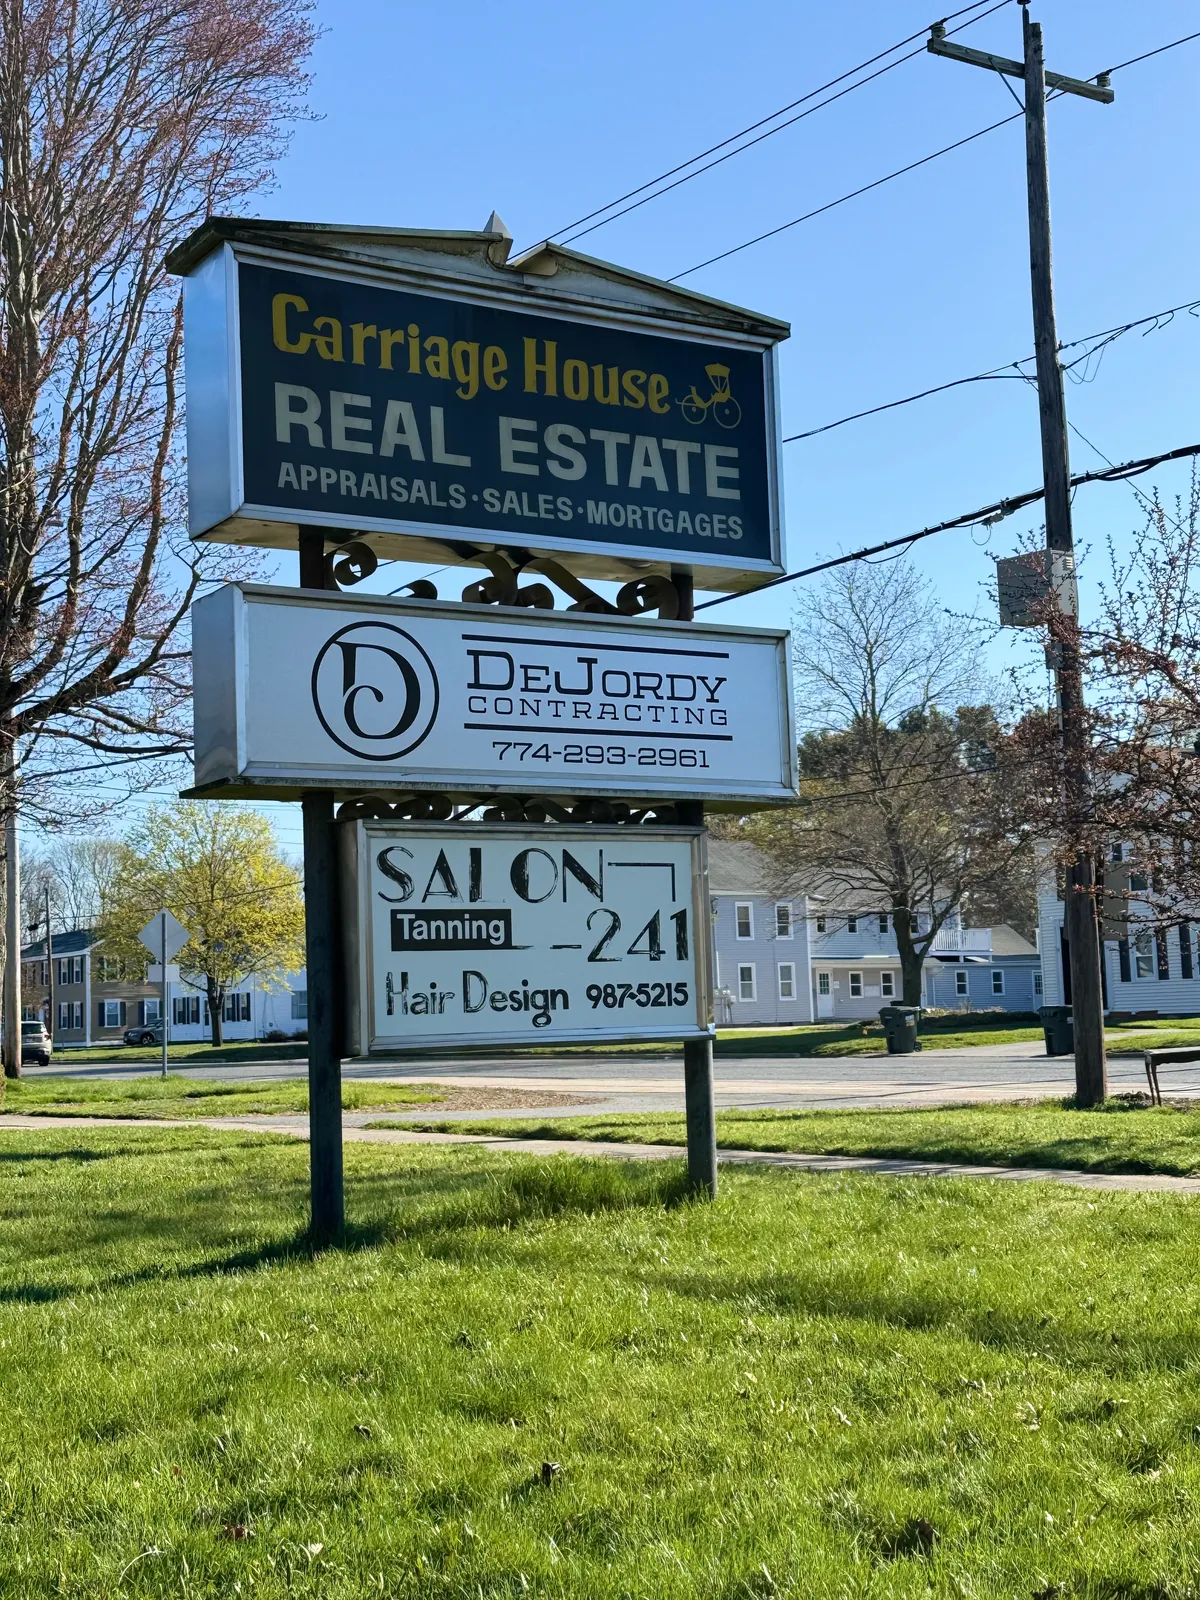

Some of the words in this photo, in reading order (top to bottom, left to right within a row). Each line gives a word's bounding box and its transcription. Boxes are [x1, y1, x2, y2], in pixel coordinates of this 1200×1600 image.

[272, 293, 508, 400] Carriage
[522, 337, 671, 414] House
[274, 382, 472, 468] REAL
[498, 416, 742, 500] ESTATE
[277, 461, 467, 509] APPRAISALS
[483, 488, 574, 521] SALES
[586, 500, 744, 540] MORTGAGES
[468, 696, 729, 727] CONTRACTING
[492, 741, 710, 768] 774-293-2961
[376, 846, 604, 903] SALON
[397, 914, 505, 943] Tanning
[586, 908, 689, 963] 241
[386, 972, 455, 1016] Hair
[463, 971, 569, 1028] Design
[585, 982, 689, 1009] 987-5215
